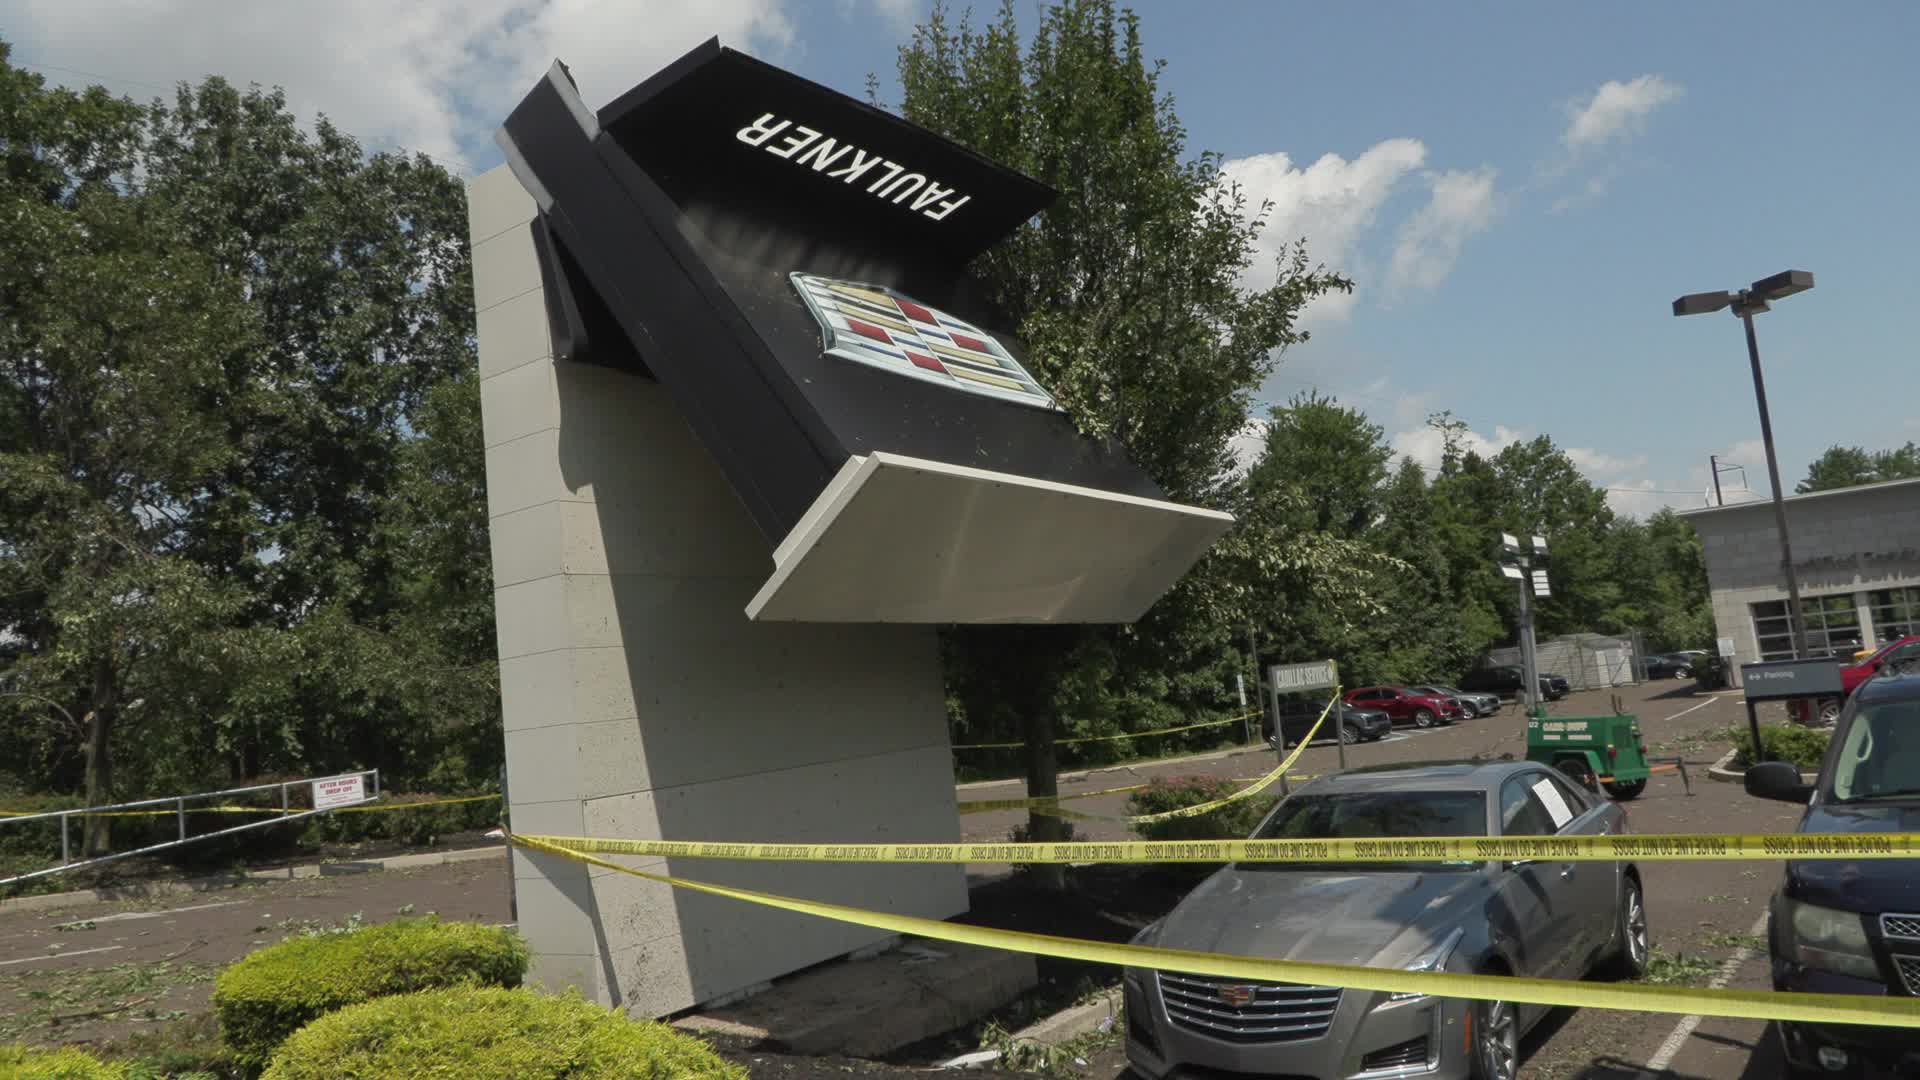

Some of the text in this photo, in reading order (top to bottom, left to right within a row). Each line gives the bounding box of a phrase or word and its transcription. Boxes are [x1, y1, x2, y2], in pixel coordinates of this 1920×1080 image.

[736, 113, 971, 220] FAULKNER
[1277, 666, 1328, 688] CADILLAC SERVICE
[1244, 842, 1327, 858] POLICE LINE DO NOT CROSS
[1354, 841, 1446, 857] POLICE LINE DO NOT CROSS
[1476, 839, 1578, 856] POLICE LINE DO NOT CROSS
[1612, 838, 1727, 856] POLICE LINE DO NOT CROSS
[1763, 836, 1891, 854] POLICE LINE DO NOT CROSS
